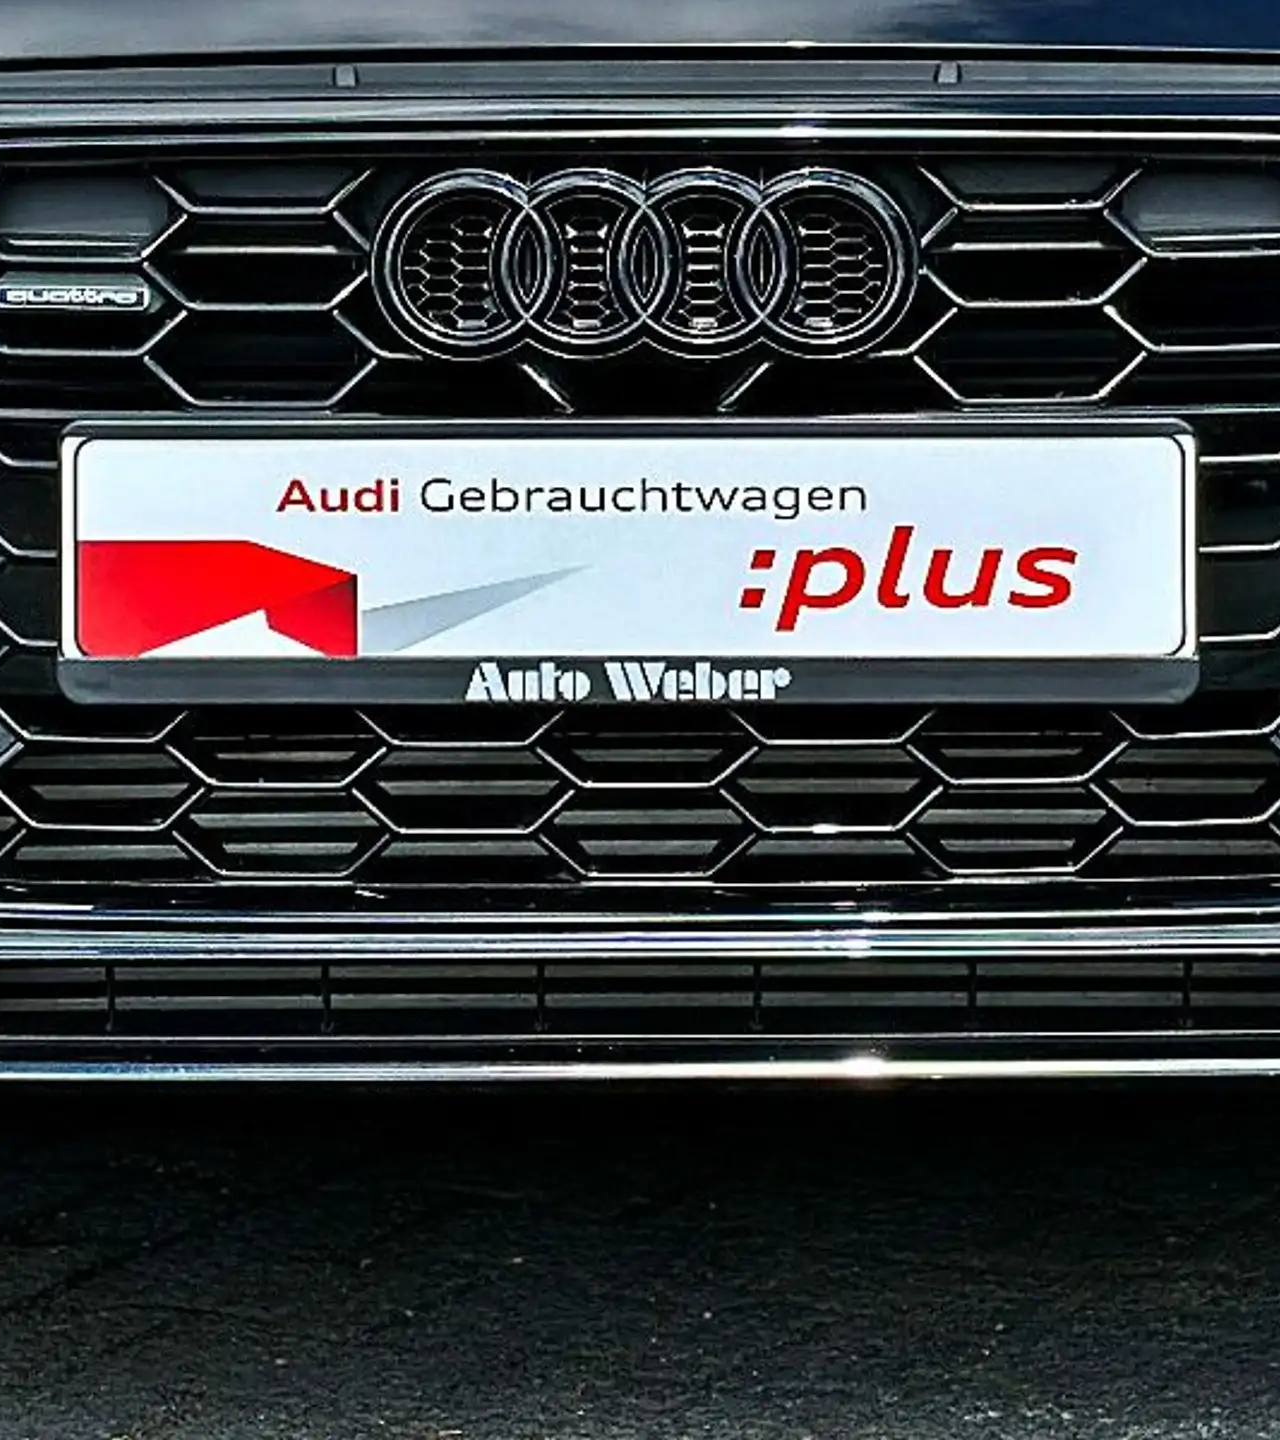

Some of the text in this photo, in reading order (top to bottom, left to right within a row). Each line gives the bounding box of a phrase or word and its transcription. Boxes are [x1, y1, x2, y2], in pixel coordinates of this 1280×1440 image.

[6, 288, 139, 307] quattro
[277, 477, 867, 520] Audi Gebrauchtwagen
[465, 661, 793, 702] Auto Weber
